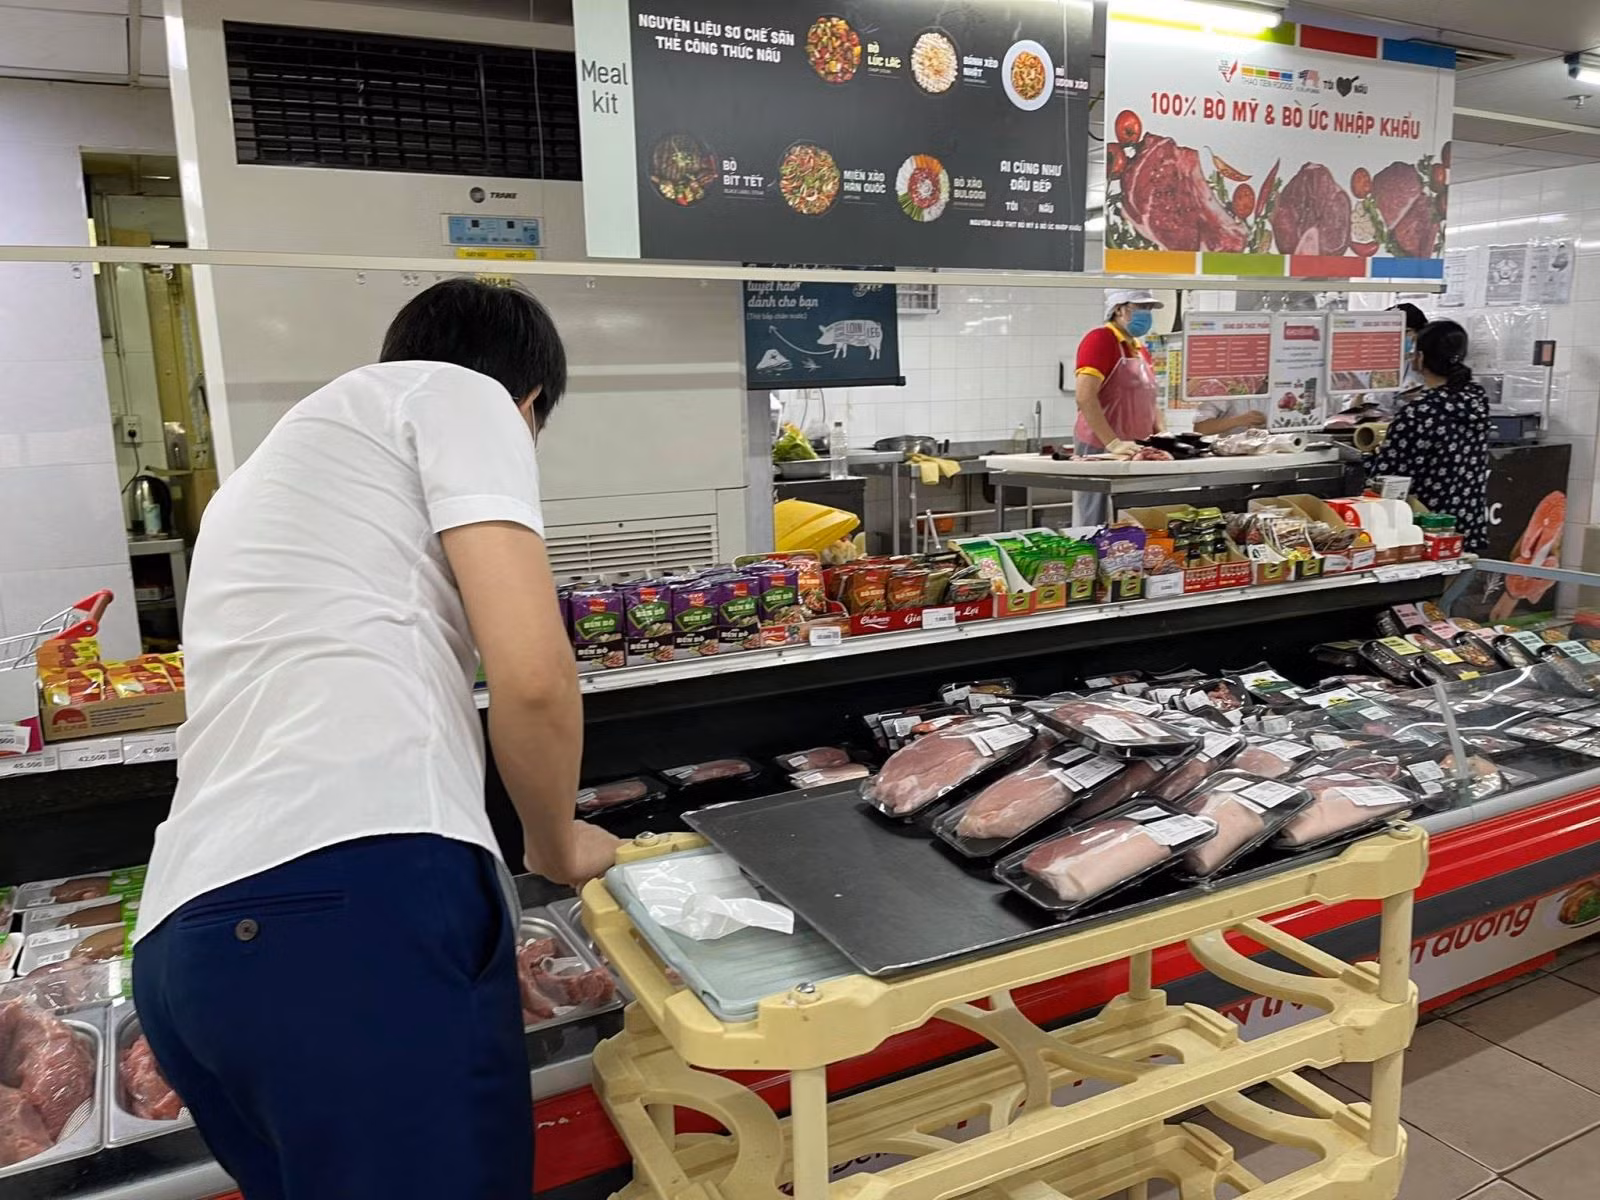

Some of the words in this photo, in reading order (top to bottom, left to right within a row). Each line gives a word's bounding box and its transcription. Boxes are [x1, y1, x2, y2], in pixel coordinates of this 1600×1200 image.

[638, 13, 691, 33] NGUYÊN
[694, 20, 722, 38] LIỆU
[744, 27, 771, 43] CHẾ
[685, 38, 718, 56] CÔNG
[721, 42, 754, 60] THỨC
[756, 47, 781, 63] NẤU
[581, 59, 628, 85] Meal
[592, 91, 619, 114] kit
[1150, 92, 1197, 117] 100%
[1203, 90, 1225, 120] BÒ
[1232, 98, 1259, 123] MỸ
[1264, 104, 1276, 125] &
[1282, 100, 1302, 128] BÒ
[1308, 102, 1329, 131] ÚC
[1334, 111, 1375, 138] NHẬP
[1379, 110, 1421, 140] KHẨU
[723, 157, 737, 171] BÒ
[1000, 160, 1010, 173] AI
[1041, 164, 1063, 176] NHƯ
[723, 172, 741, 186] BÍT
[743, 175, 764, 188] TẾT
[1033, 178, 1052, 193] BẾP
[490, 191, 518, 200] TRANE
[953, 189, 986, 199] BULGOGI
[778, 295, 797, 308] cho
[799, 295, 819, 310] bạn
[846, 322, 863, 333] LOIN
